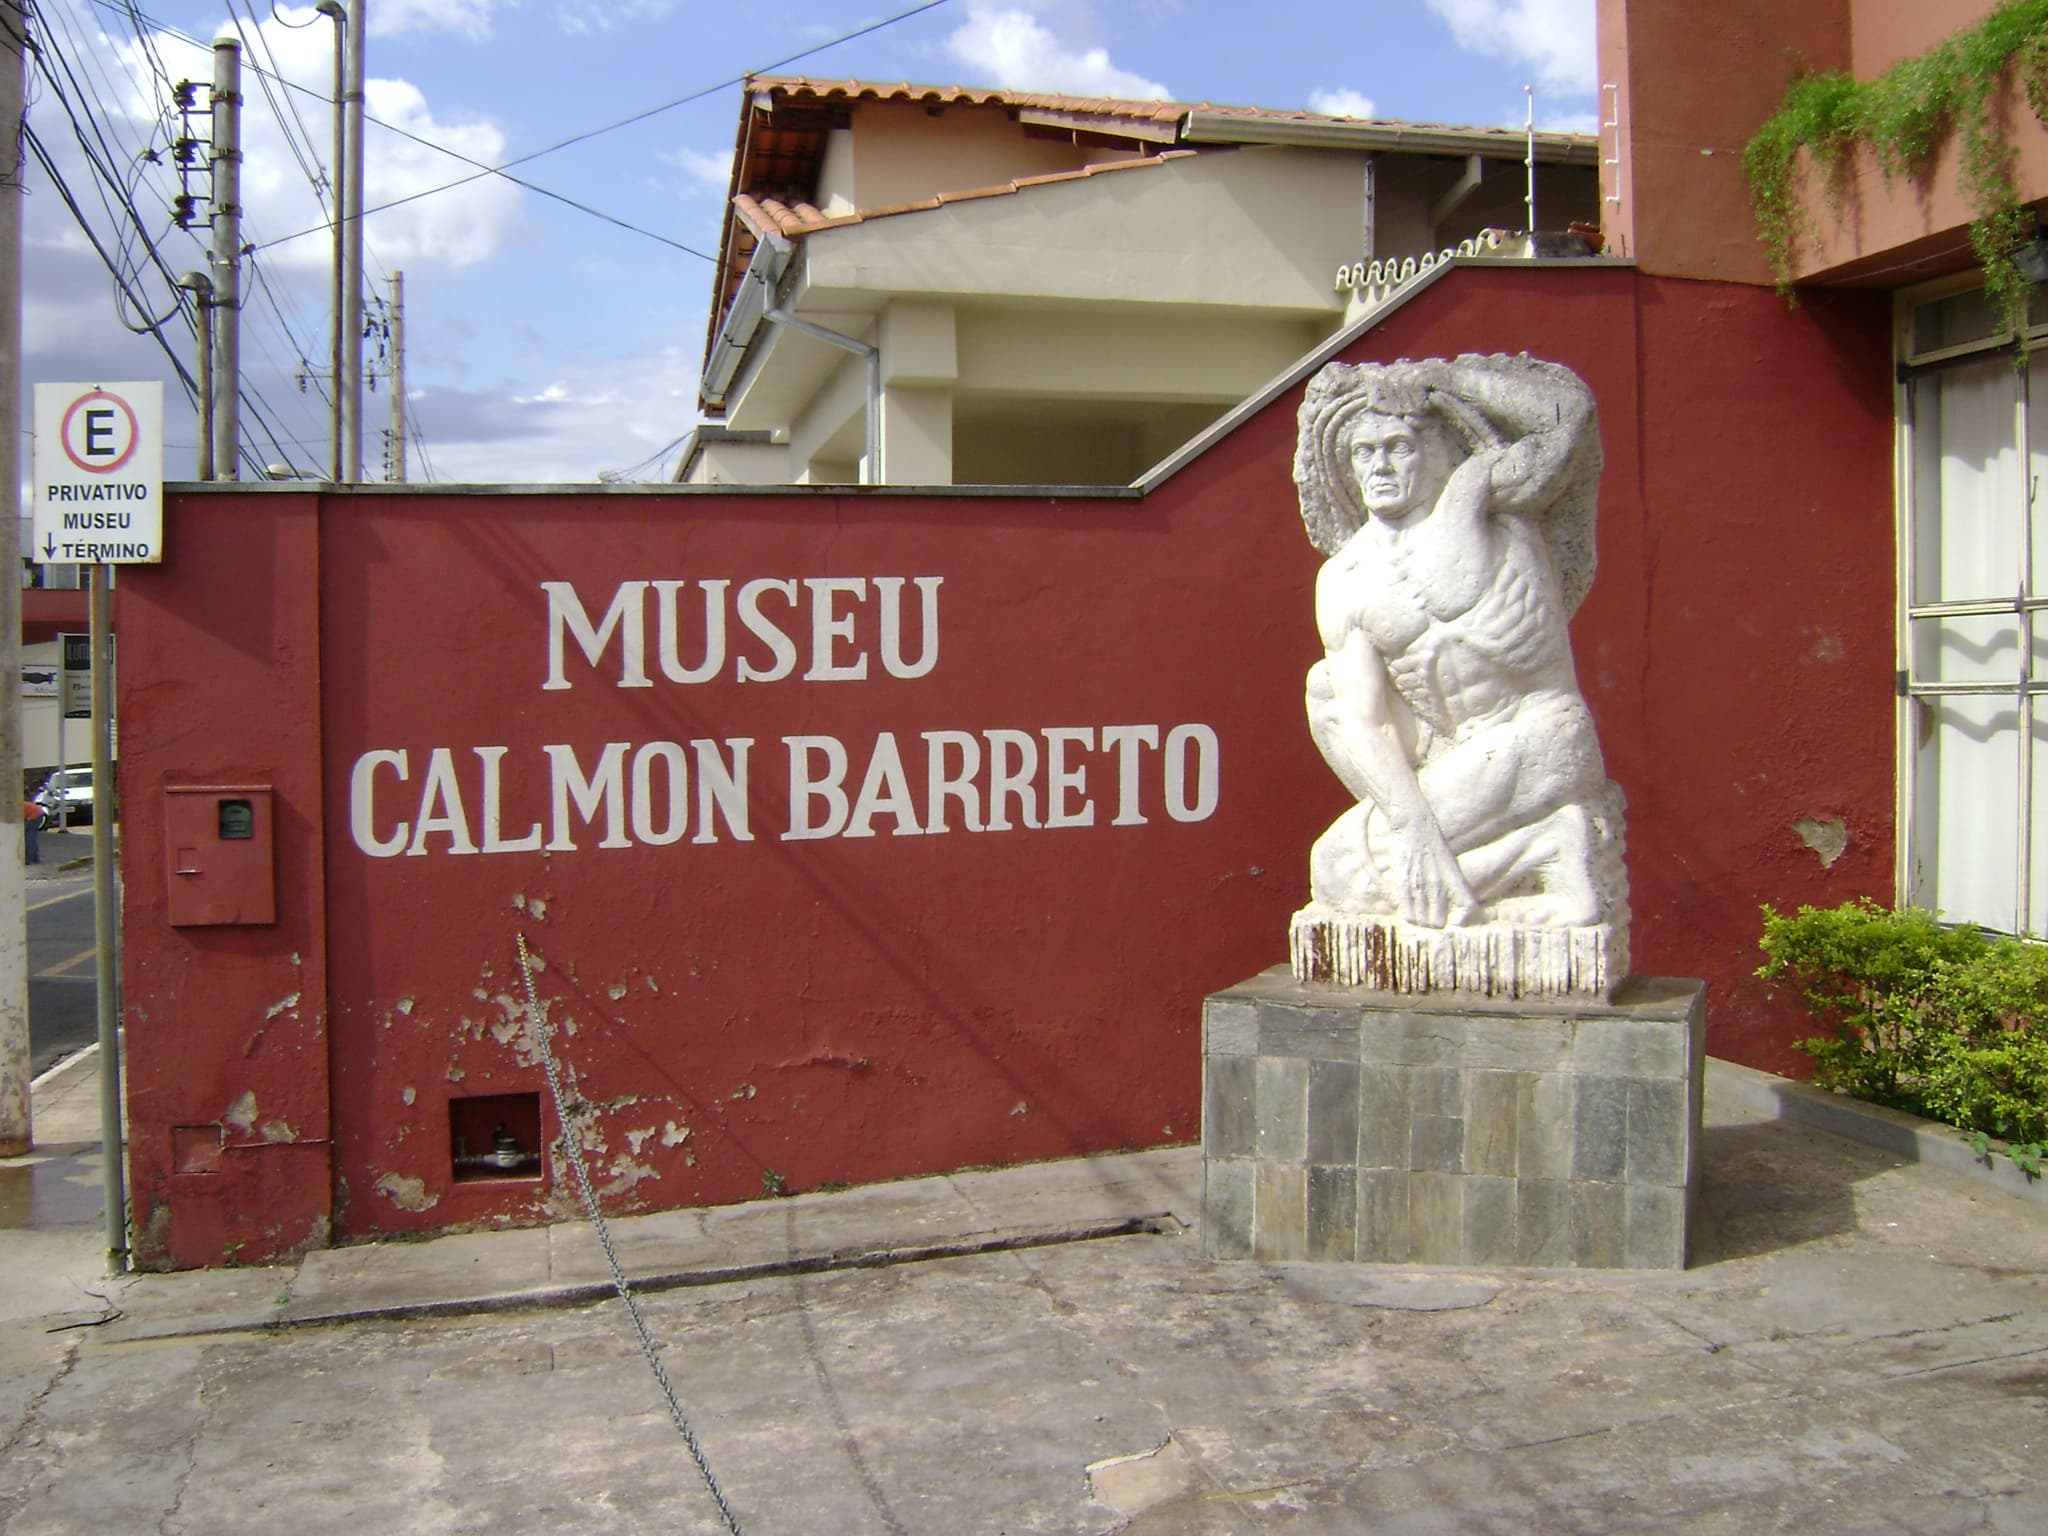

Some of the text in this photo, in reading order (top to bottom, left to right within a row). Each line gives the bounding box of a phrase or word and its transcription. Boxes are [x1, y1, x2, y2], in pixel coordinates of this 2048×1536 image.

[86, 410, 115, 456] E
[48, 484, 147, 501] PRIVATIVO
[64, 513, 131, 529] MUSEU
[62, 538, 149, 558] TÉRMINO
[540, 576, 944, 690] MUSEU
[349, 723, 1220, 858] CALMON BARRETO
